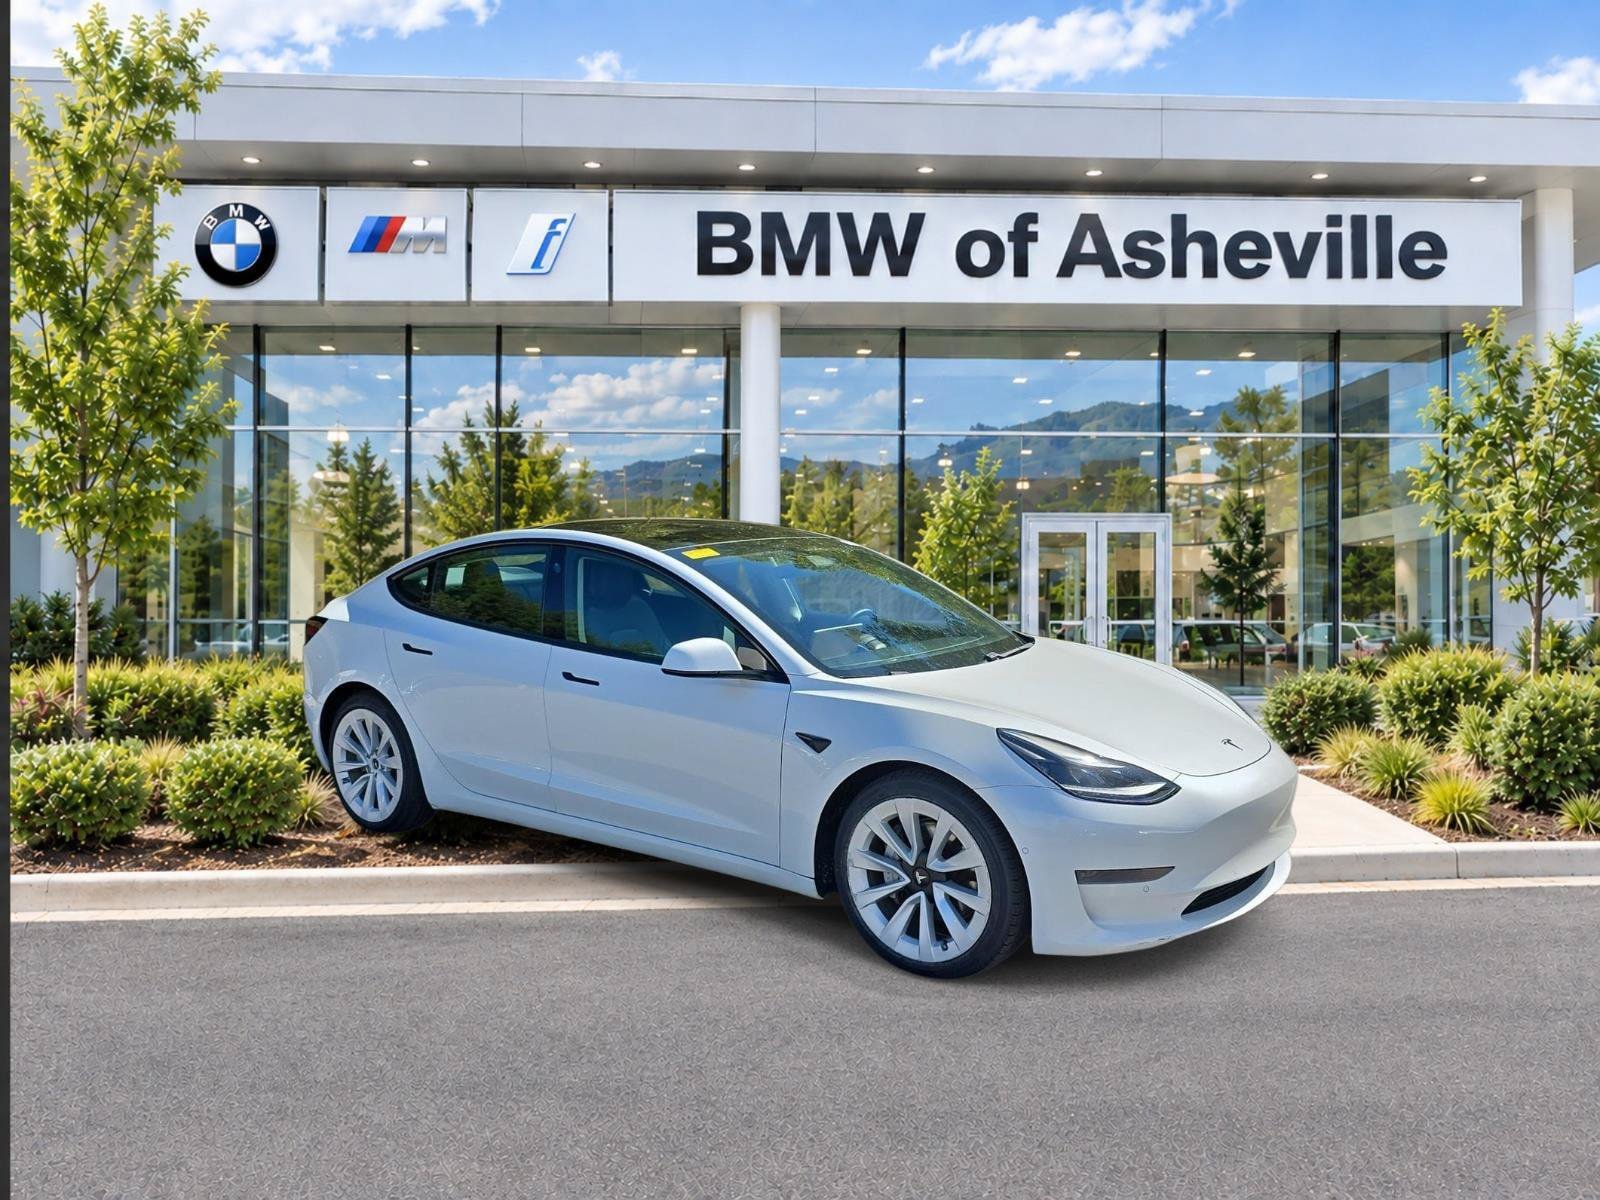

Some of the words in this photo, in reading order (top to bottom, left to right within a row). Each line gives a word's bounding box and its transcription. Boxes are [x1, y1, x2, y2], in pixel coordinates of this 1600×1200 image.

[203, 204, 270, 231] BMW
[389, 215, 447, 254] M
[697, 210, 926, 277] BMW
[955, 212, 1039, 278] of
[1056, 213, 1448, 281] Asheville
